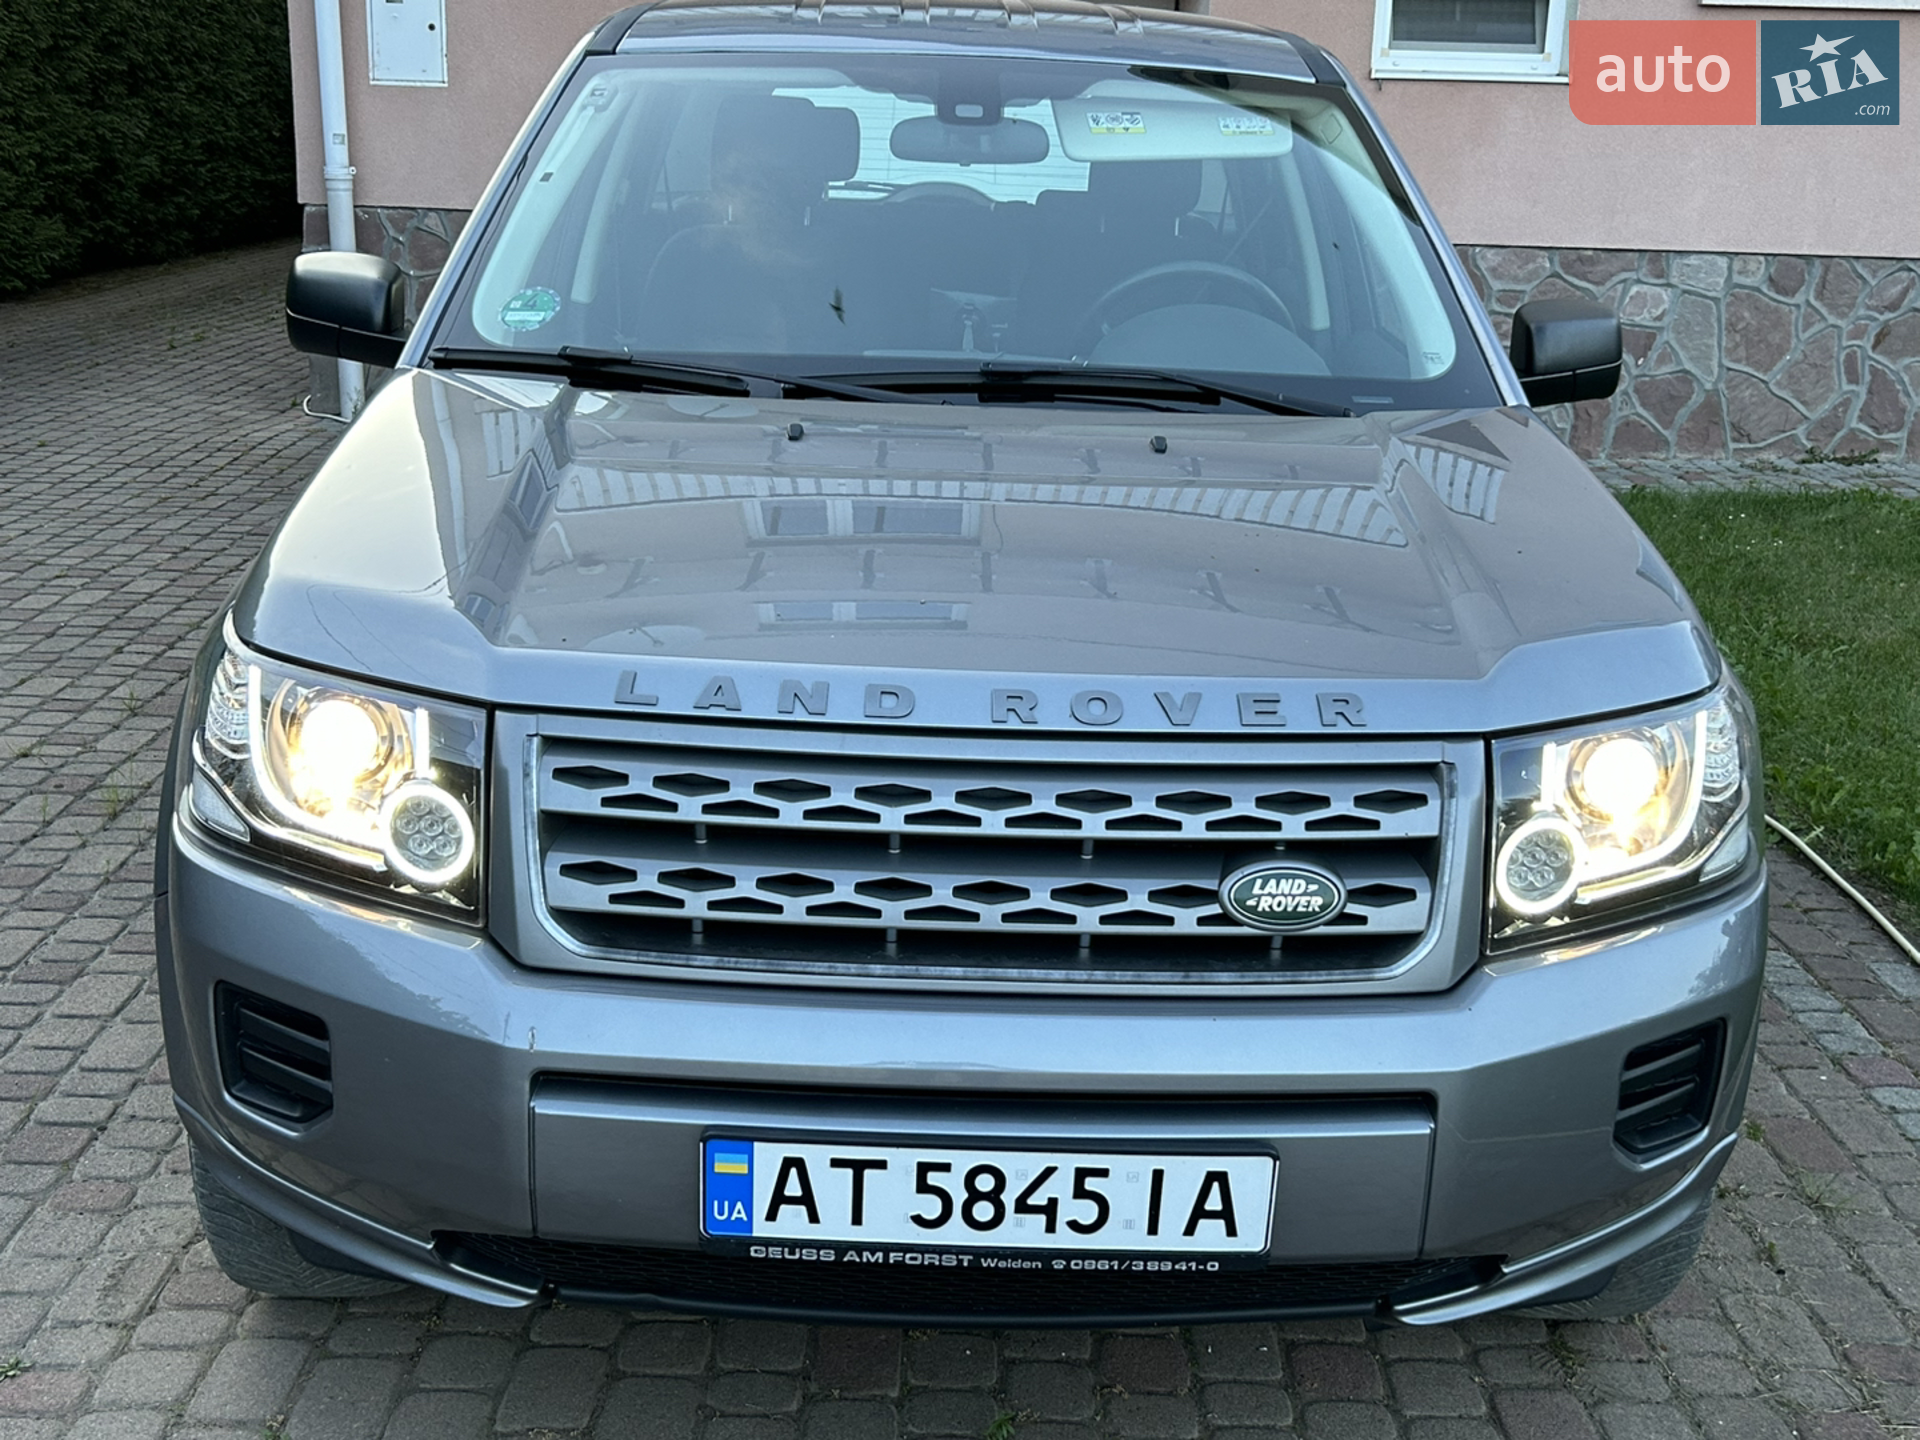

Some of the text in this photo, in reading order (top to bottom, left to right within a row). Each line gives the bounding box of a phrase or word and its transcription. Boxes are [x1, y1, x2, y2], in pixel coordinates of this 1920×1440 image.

[614, 670, 1368, 727] LAND ROVER
[1252, 878, 1306, 895] LAND
[1257, 896, 1324, 912] ROVER
[764, 1156, 1239, 1238] AT 5845 IA
[713, 1200, 748, 1221] UA
[843, 1250, 884, 1264] AM
[889, 1253, 974, 1268] FORST
